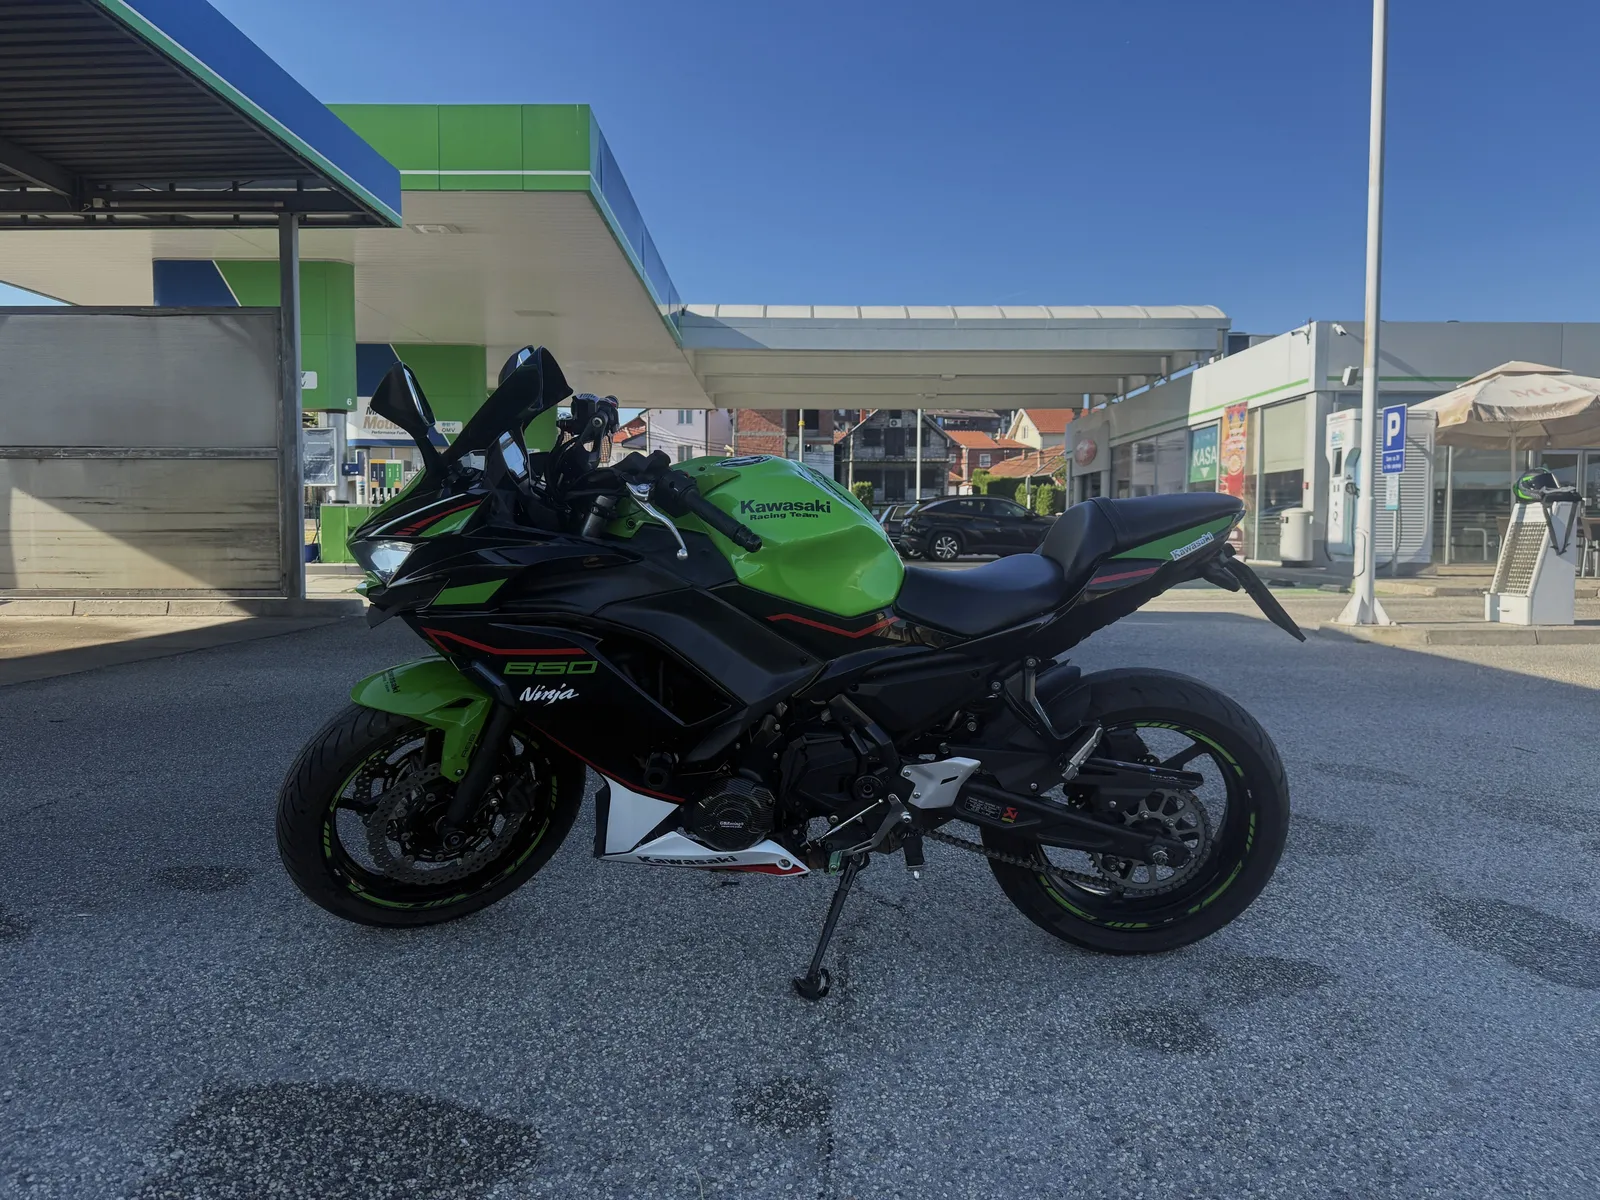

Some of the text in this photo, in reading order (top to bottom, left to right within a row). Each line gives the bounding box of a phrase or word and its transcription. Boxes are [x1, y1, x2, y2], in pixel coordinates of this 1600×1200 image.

[347, 398, 352, 406] 6
[1387, 412, 1401, 447] P
[1193, 445, 1217, 467] KASA
[740, 500, 831, 514] Kawasaki
[750, 512, 787, 520] Racing
[1171, 532, 1214, 560] Kawasaki
[503, 661, 599, 675] 650
[519, 683, 580, 707] Ninja
[637, 855, 739, 865] Kawasaki
